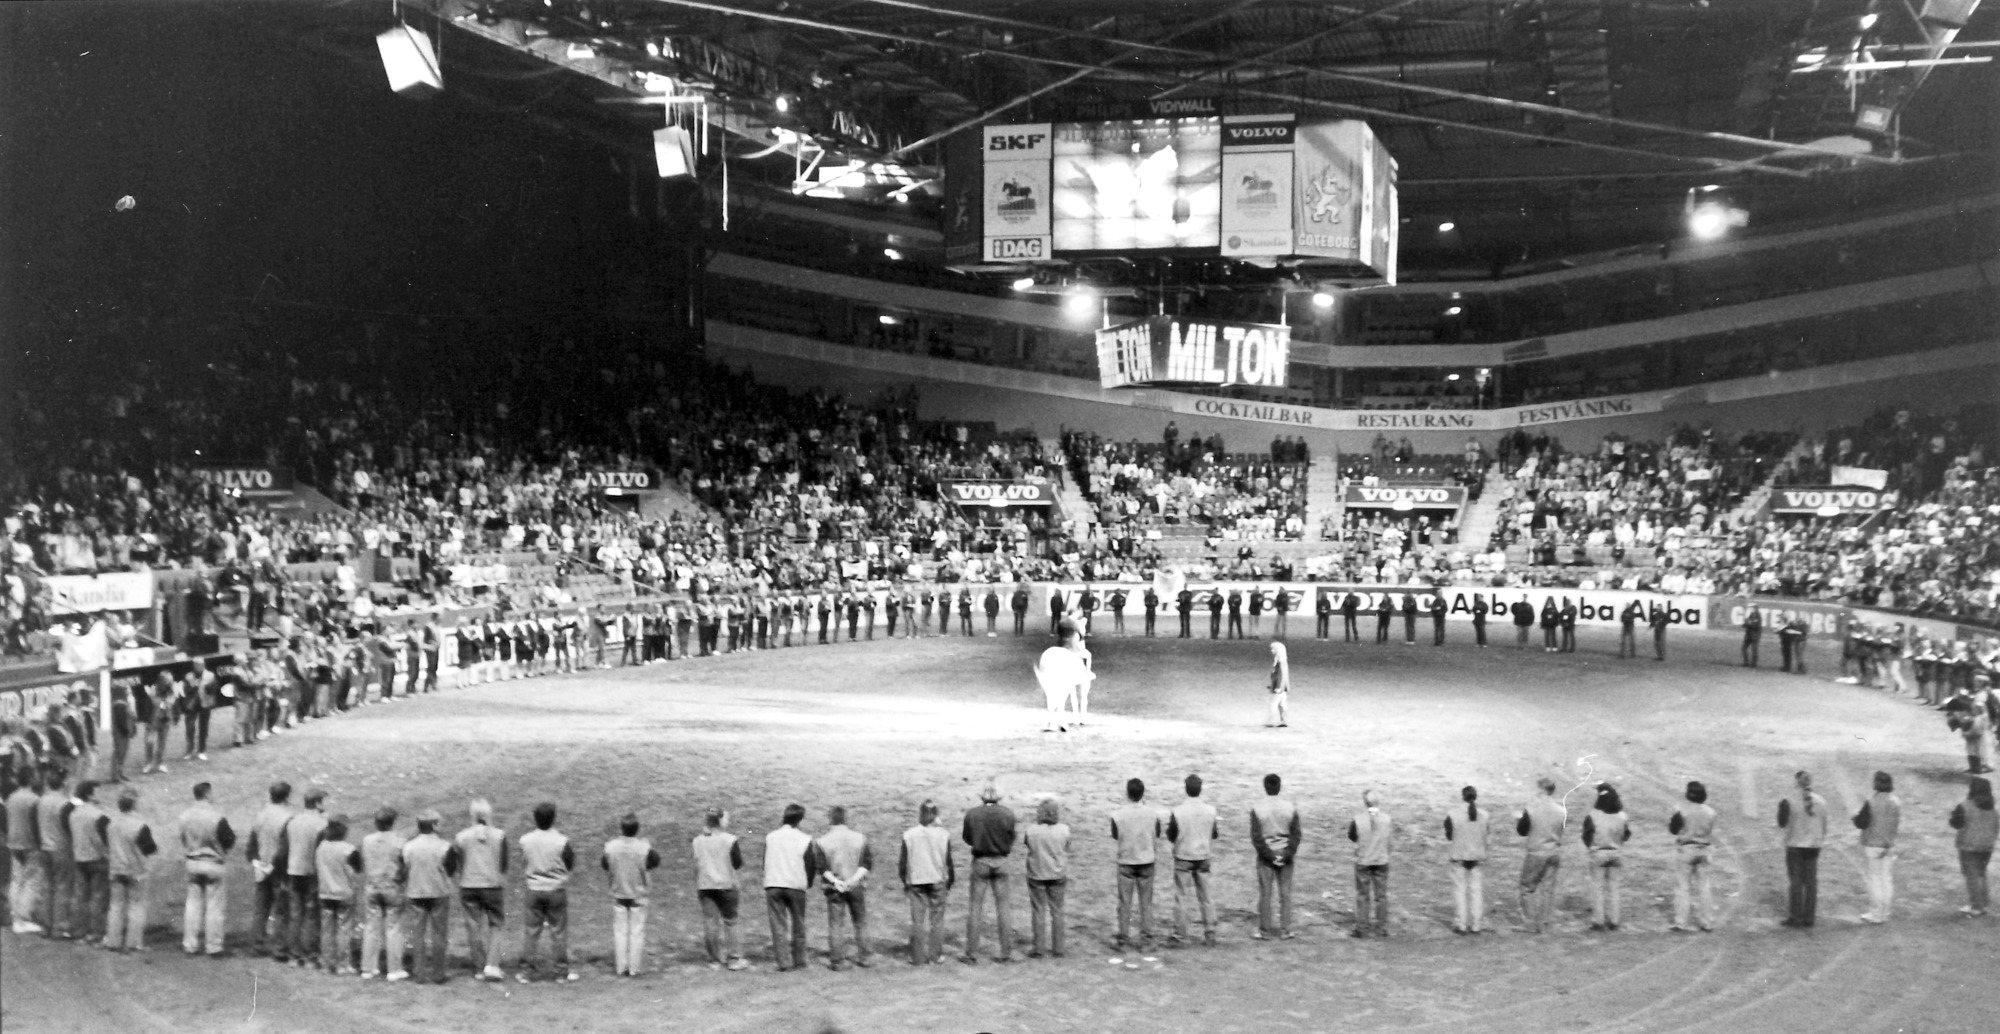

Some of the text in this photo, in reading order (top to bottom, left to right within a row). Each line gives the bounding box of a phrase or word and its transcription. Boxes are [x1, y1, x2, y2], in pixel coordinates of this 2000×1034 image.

[1150, 99, 1215, 113] VIDIWALL
[1230, 127, 1288, 138] VOLVO
[989, 134, 1045, 151] SKF
[1167, 322, 1288, 386] MILTON
[1195, 399, 1313, 425] COCKTAILBAR
[1357, 413, 1473, 428] RESTAURANG
[952, 484, 1040, 500] VOLVO
[1358, 488, 1449, 502] VOLVO
[1783, 491, 1877, 507] VOLVO
[1541, 595, 1614, 621] Aba
